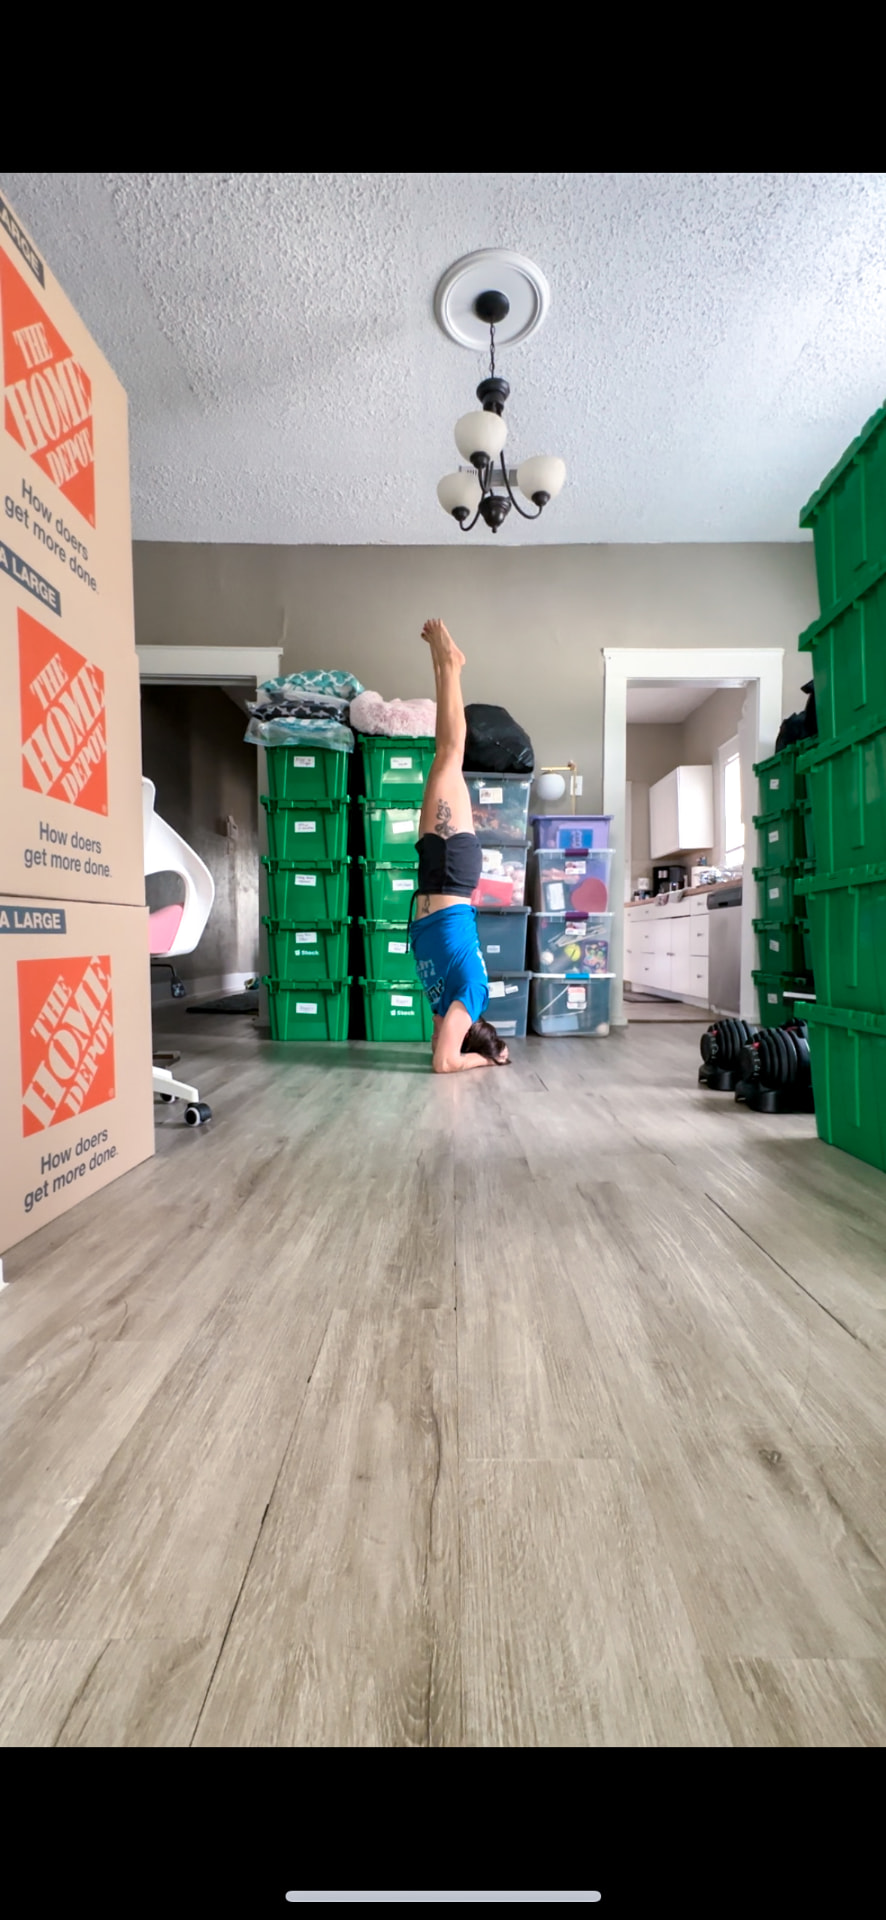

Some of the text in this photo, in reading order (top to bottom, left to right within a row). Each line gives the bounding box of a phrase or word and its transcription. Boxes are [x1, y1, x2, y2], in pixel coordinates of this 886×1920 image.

[0, 207, 40, 277] ARGE
[12, 321, 53, 369] THE
[4, 356, 92, 453] HOME
[46, 427, 94, 487] DEPOT
[4, 495, 29, 529] get
[33, 521, 67, 562] more
[22, 478, 89, 561] How doers
[12, 556, 57, 608] LARGE
[29, 652, 70, 710] THE
[21, 659, 105, 795] HOME
[60, 722, 107, 804] DEPOT
[24, 848, 47, 869] get
[50, 853, 81, 872] more
[39, 821, 102, 854] How doers
[14, 911, 61, 929] LARGE
[30, 974, 72, 1044] THE
[22, 955, 113, 1129] HOME
[64, 1010, 114, 1116] DEPOT
[41, 1129, 108, 1175] How doers
[24, 1180, 49, 1213] get
[53, 1162, 86, 1193] more
